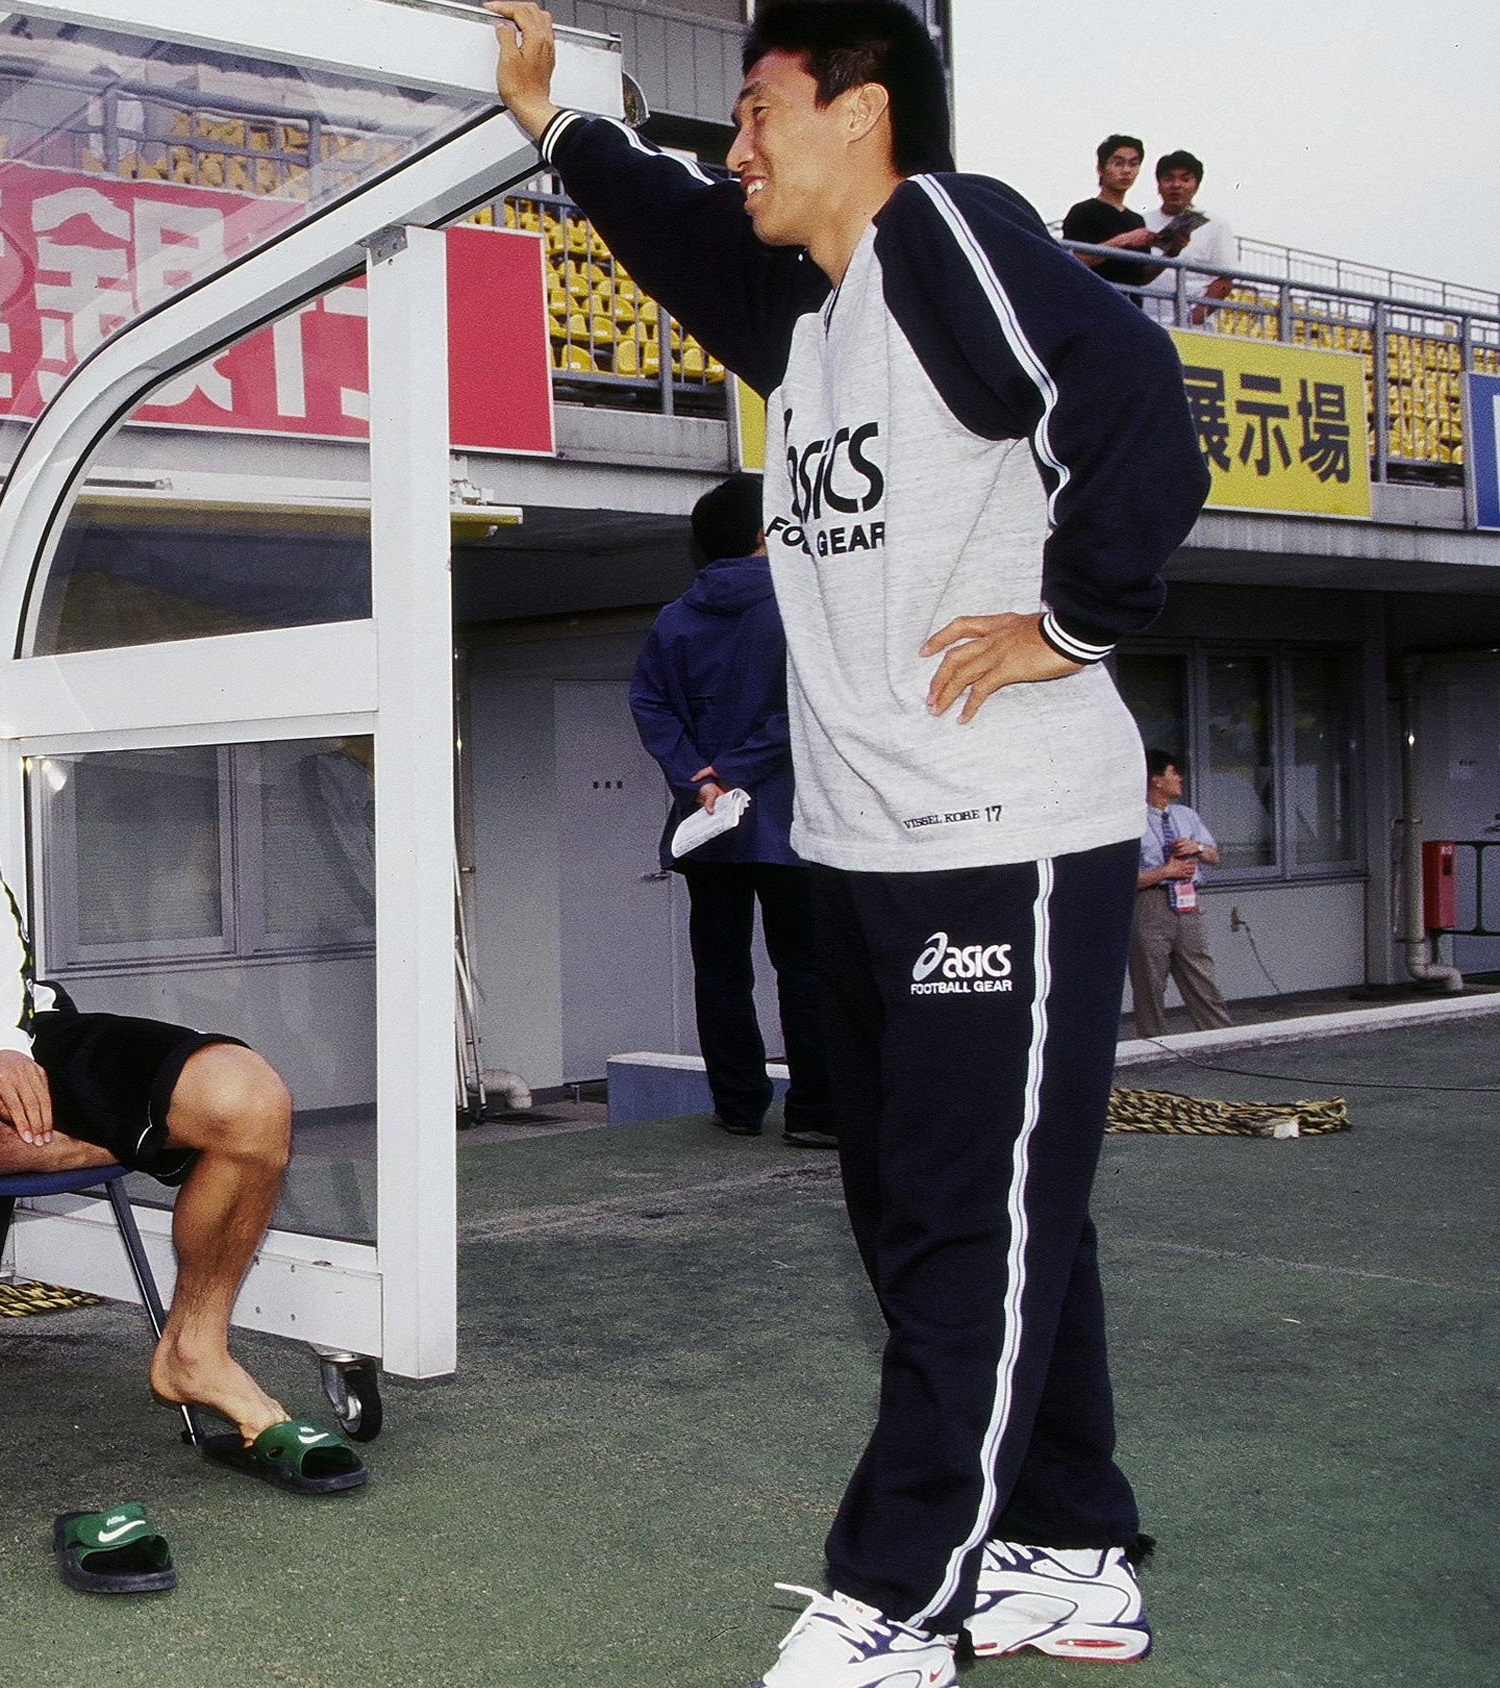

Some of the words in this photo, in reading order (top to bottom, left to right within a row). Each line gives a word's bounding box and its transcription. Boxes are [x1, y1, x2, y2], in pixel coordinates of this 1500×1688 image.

[817, 521, 885, 557] GEAR
[903, 814, 942, 829] VISSEL
[944, 810, 980, 823] KOBE
[985, 805, 1002, 822] 17
[942, 943, 1012, 979] asics
[911, 981, 971, 995] FOOTBALL
[973, 979, 1013, 993] GEAR
